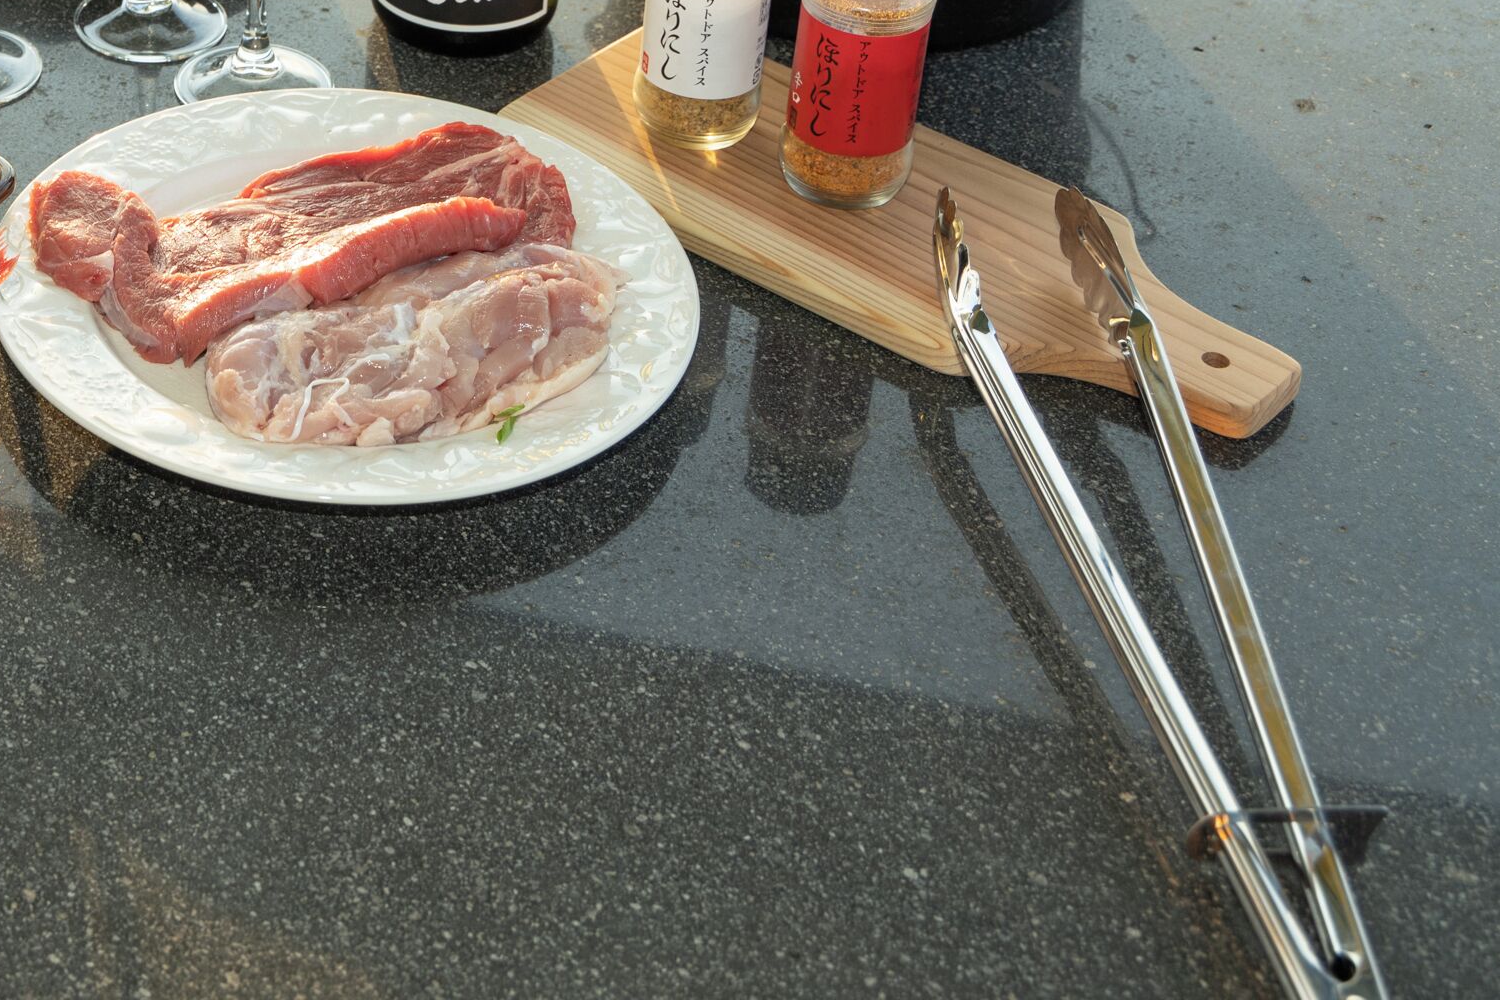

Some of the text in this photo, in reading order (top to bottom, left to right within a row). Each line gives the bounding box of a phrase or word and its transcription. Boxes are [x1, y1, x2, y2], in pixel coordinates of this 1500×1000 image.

[693, 48, 709, 87] スパイス
[809, 33, 840, 137] ほりにし
[845, 41, 872, 144] アウトドア スパイス
